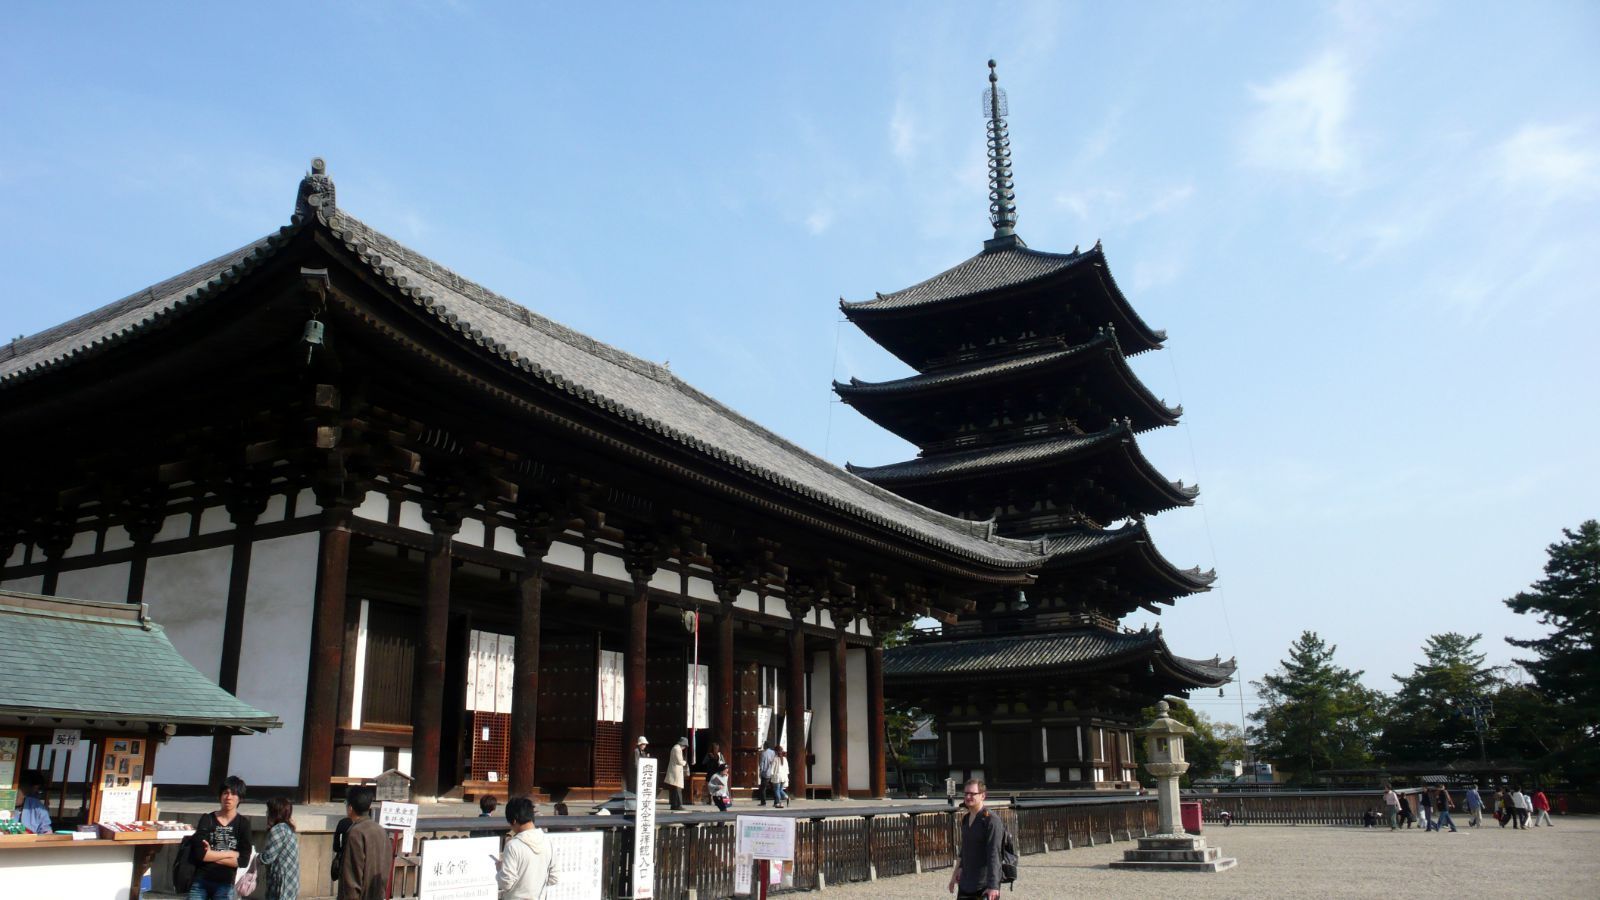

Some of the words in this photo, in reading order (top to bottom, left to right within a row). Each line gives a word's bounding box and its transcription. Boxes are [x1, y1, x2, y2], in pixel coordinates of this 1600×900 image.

[56, 735, 77, 745] 受付
[434, 860, 469, 876] 東金堂
